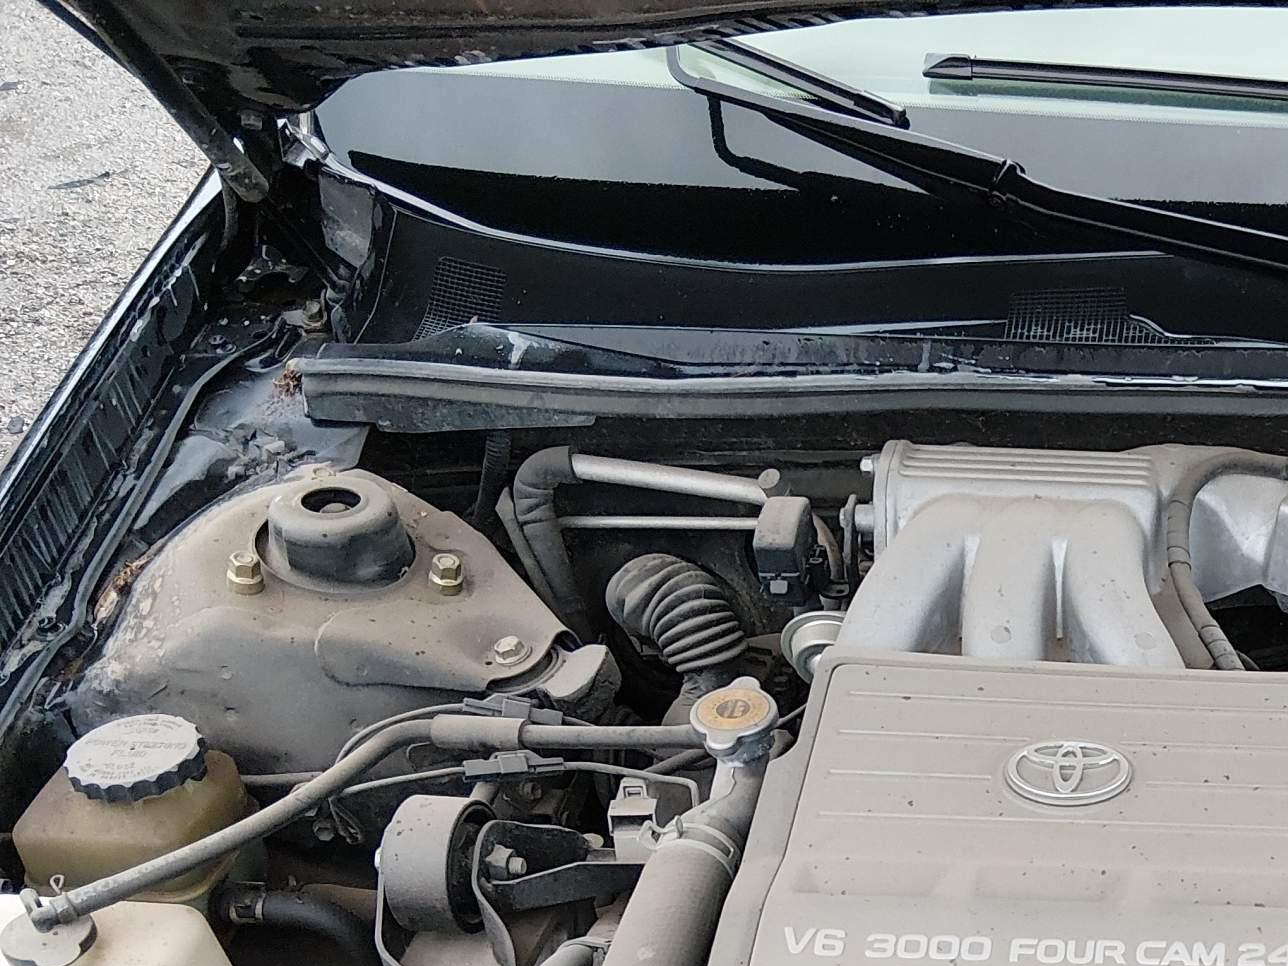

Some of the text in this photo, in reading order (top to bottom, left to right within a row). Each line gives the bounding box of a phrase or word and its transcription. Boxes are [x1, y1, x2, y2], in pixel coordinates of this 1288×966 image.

[783, 927, 847, 958] V6
[865, 933, 992, 962] 3000
[1009, 937, 1126, 966] FOUR
